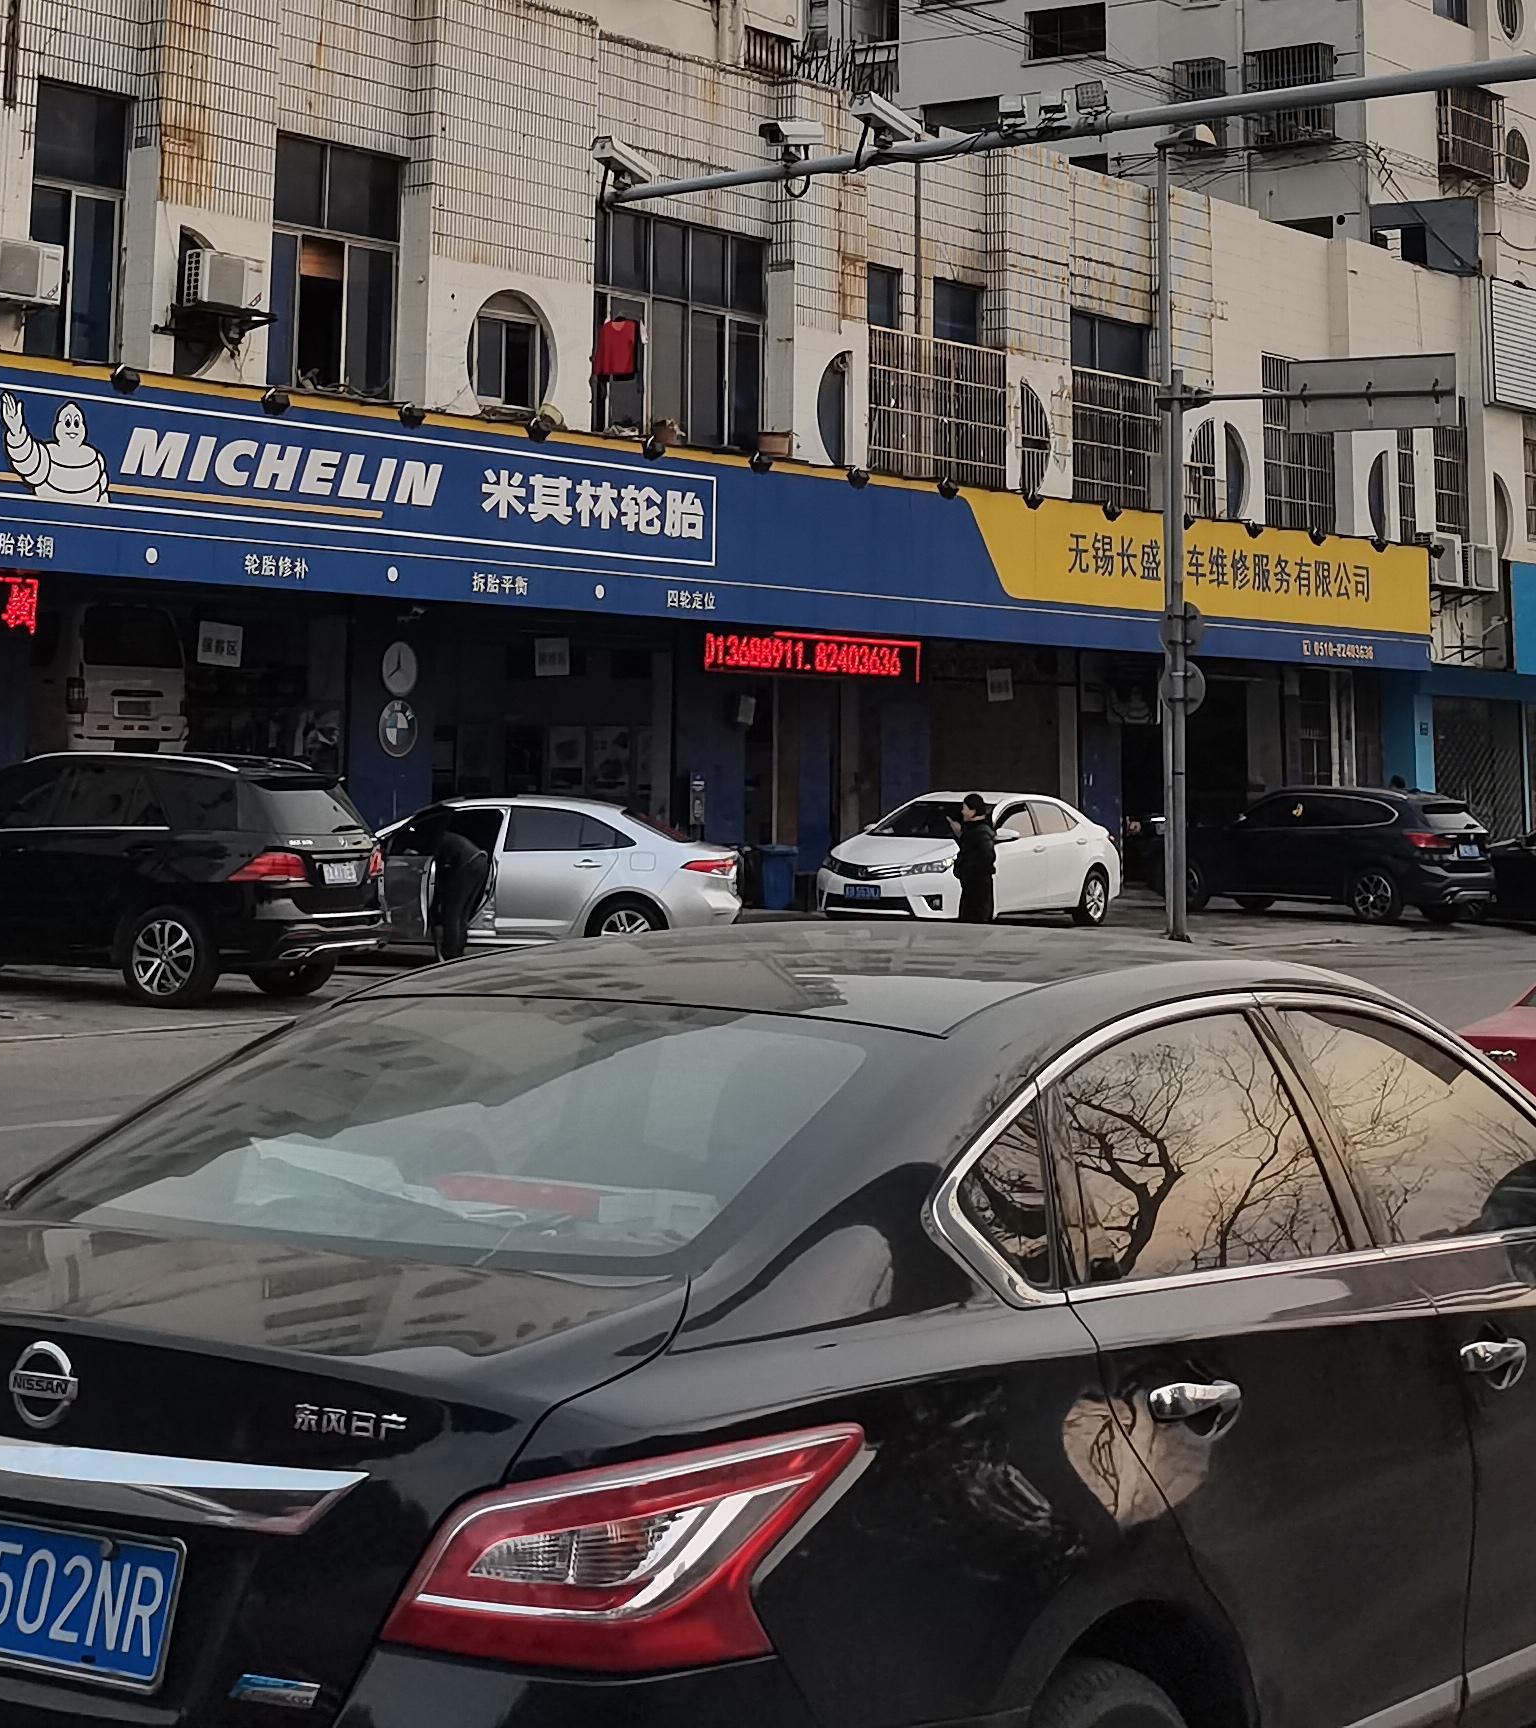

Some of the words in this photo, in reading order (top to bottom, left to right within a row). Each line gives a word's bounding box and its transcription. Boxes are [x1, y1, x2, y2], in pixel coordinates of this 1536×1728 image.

[121, 427, 444, 507] MICHELIN
[480, 467, 706, 542] 米其林轮胎
[243, 553, 310, 581] 轮胎修补
[471, 570, 529, 598] 拆胎平衡
[666, 588, 716, 612] 四轮定位
[1068, 532, 1372, 603] 无锡长盛车维修服务有限公司
[11, 1374, 70, 1396] NISSAN
[293, 1403, 408, 1440] 东风日产
